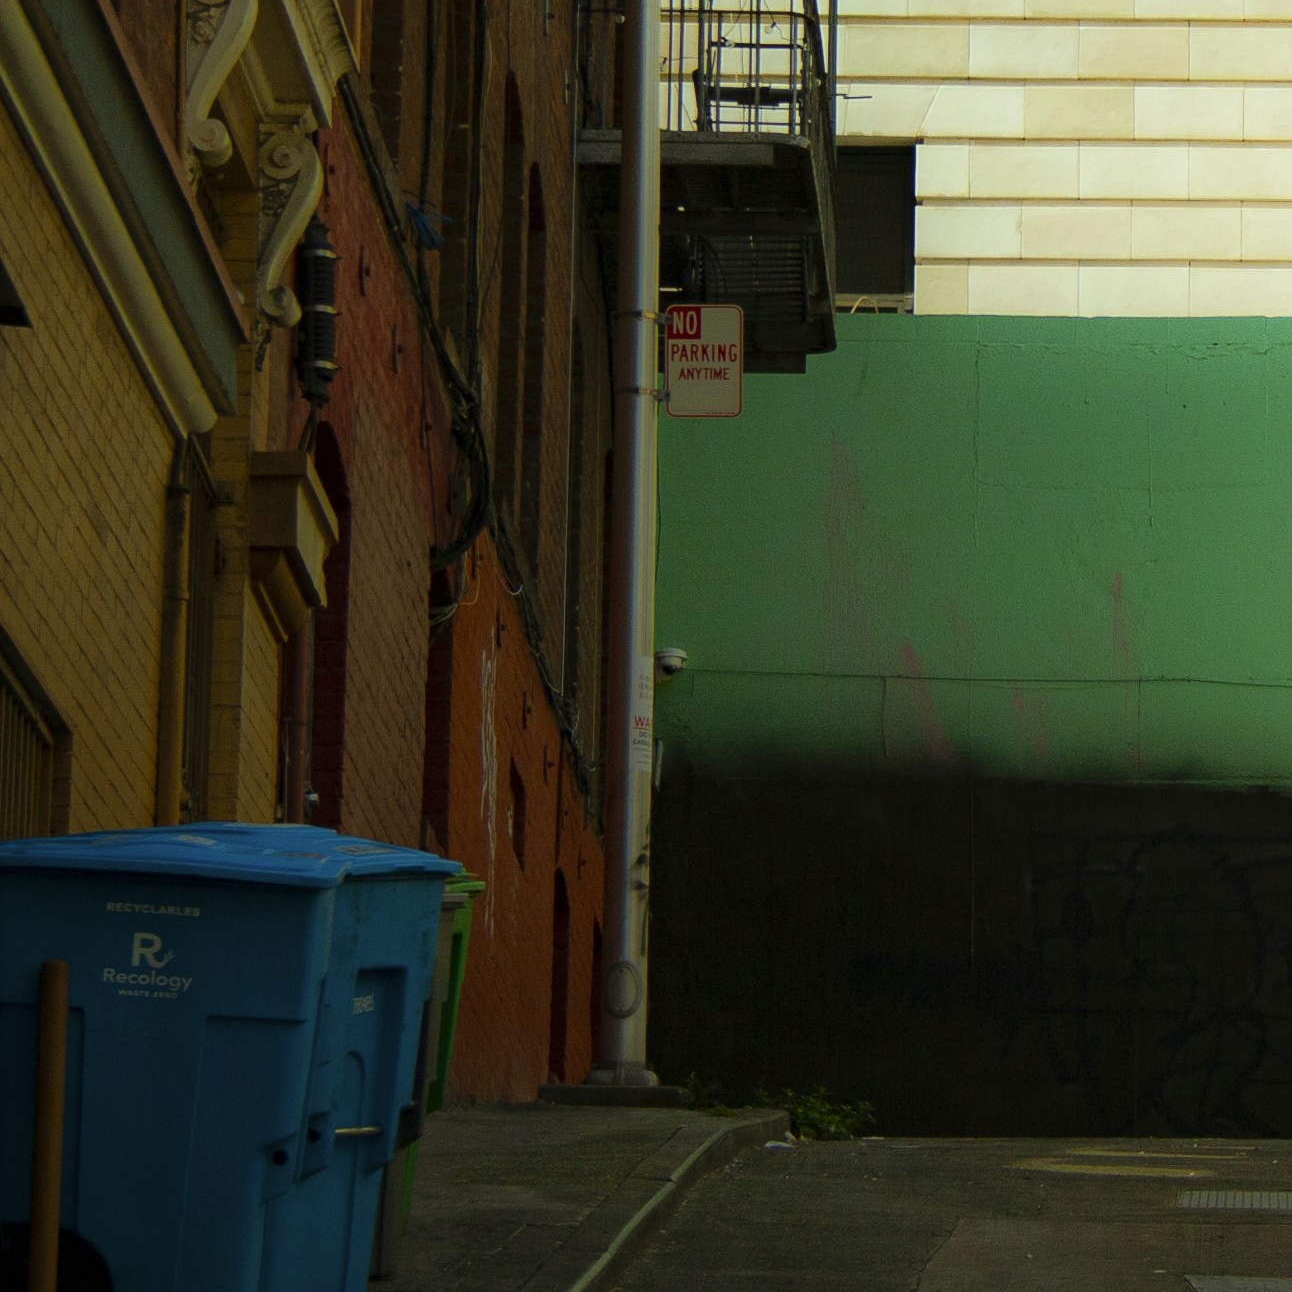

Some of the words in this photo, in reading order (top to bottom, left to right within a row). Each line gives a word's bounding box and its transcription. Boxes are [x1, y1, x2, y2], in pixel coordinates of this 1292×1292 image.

[672, 311, 698, 335] NO
[671, 344, 738, 363] PARKING
[678, 367, 730, 380] ANYTIME
[106, 901, 201, 918] RECYCLABLES
[103, 967, 193, 992] Recology
[118, 989, 150, 998] WASTE
[153, 991, 178, 999] ZERO
